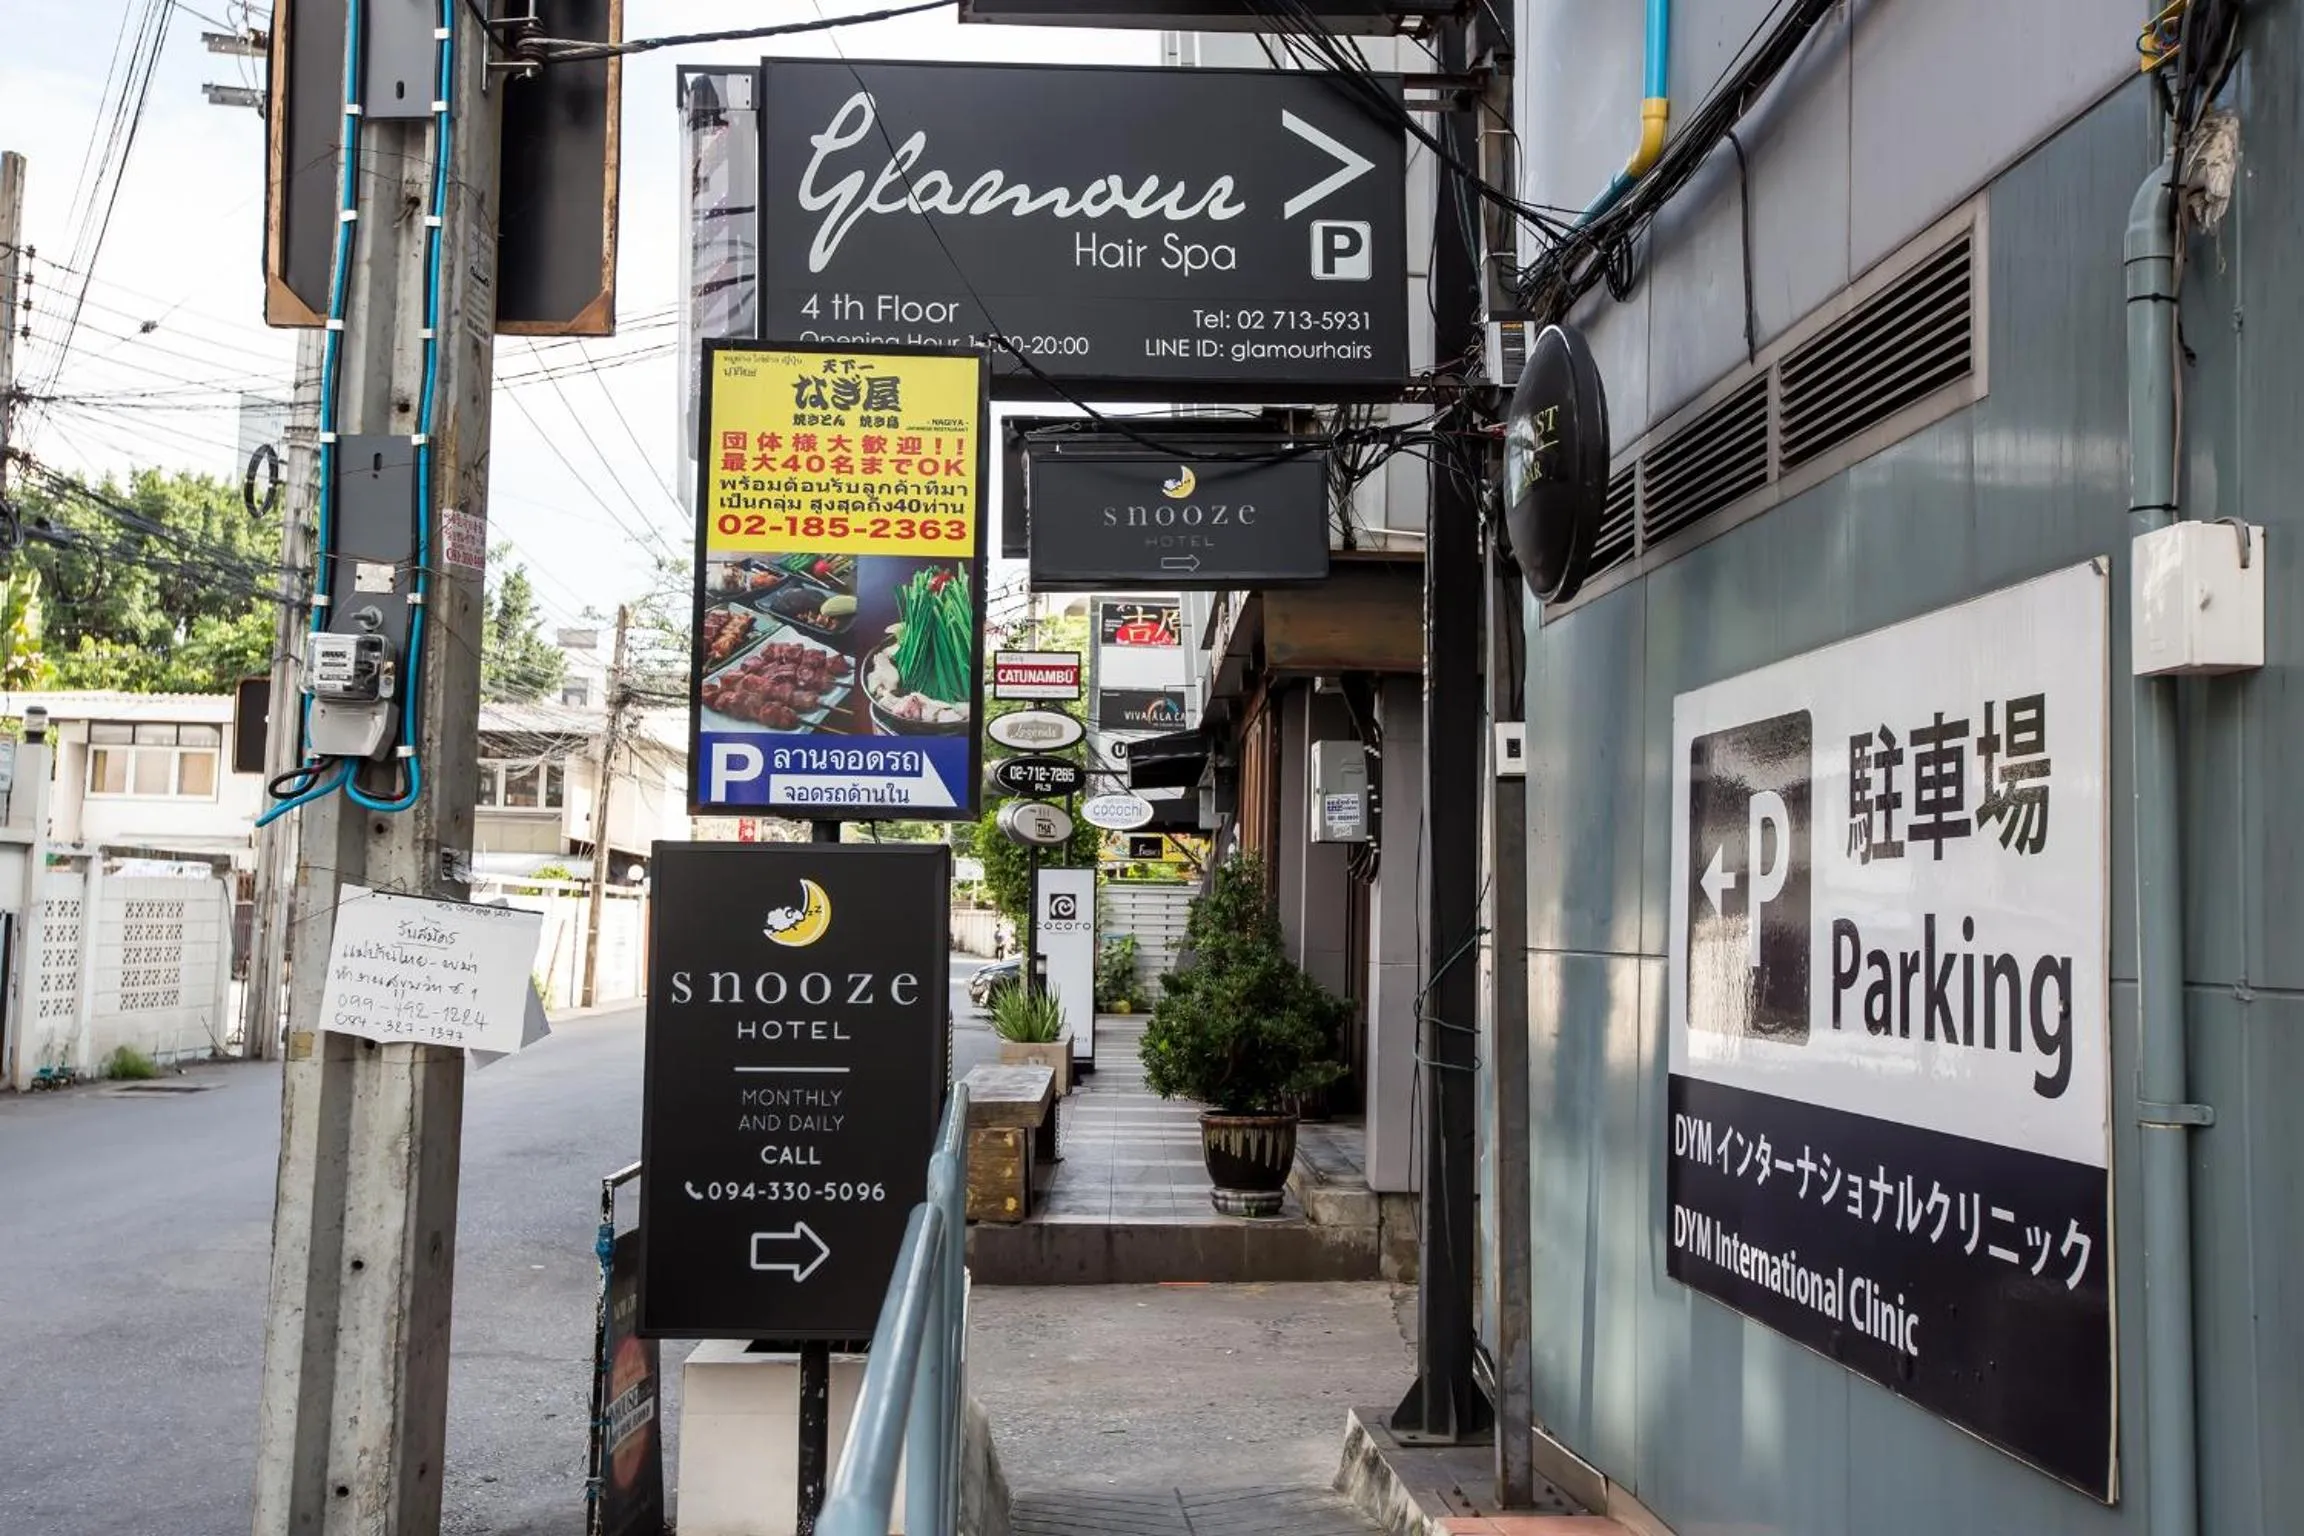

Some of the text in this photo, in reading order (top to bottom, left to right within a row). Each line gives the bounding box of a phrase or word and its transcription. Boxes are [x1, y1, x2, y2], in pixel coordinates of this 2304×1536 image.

[799, 92, 1245, 273] Glamour
[1075, 231, 1237, 277] Hair Spa
[1322, 226, 1364, 275] P
[801, 294, 960, 322] 4 th Floor
[1193, 310, 1371, 331] Tel: 02 713-5931
[969, 334, 1089, 355] 1:00-20:00
[1145, 339, 1373, 362] LINE ID: glamourhairs
[822, 359, 875, 374] 天下一
[791, 374, 902, 412] なぎ屋
[721, 452, 967, 477] 最大40名までOK
[718, 513, 967, 541] 02-185-2363
[1103, 504, 1256, 526] snooze
[1145, 535, 1215, 548] HOTEL
[773, 747, 920, 772] ลานจอดรถ
[710, 742, 764, 803] P
[1846, 693, 2052, 865] 駐車場
[784, 782, 910, 804] จอดรถด้านใน
[1748, 790, 1791, 968] P
[671, 970, 920, 1006] snooze
[1832, 913, 2073, 1100] Parking
[737, 1020, 850, 1041] HOTEL
[741, 1088, 843, 1107] MONTHLY
[738, 1114, 845, 1132] AND DAILY
[761, 1145, 821, 1166] CALL
[707, 1181, 886, 1202] 094-330-5096
[1675, 1113, 2092, 1291] DYM インターナショナルクリニック
[1674, 1204, 1920, 1357] DYM International Clinic
